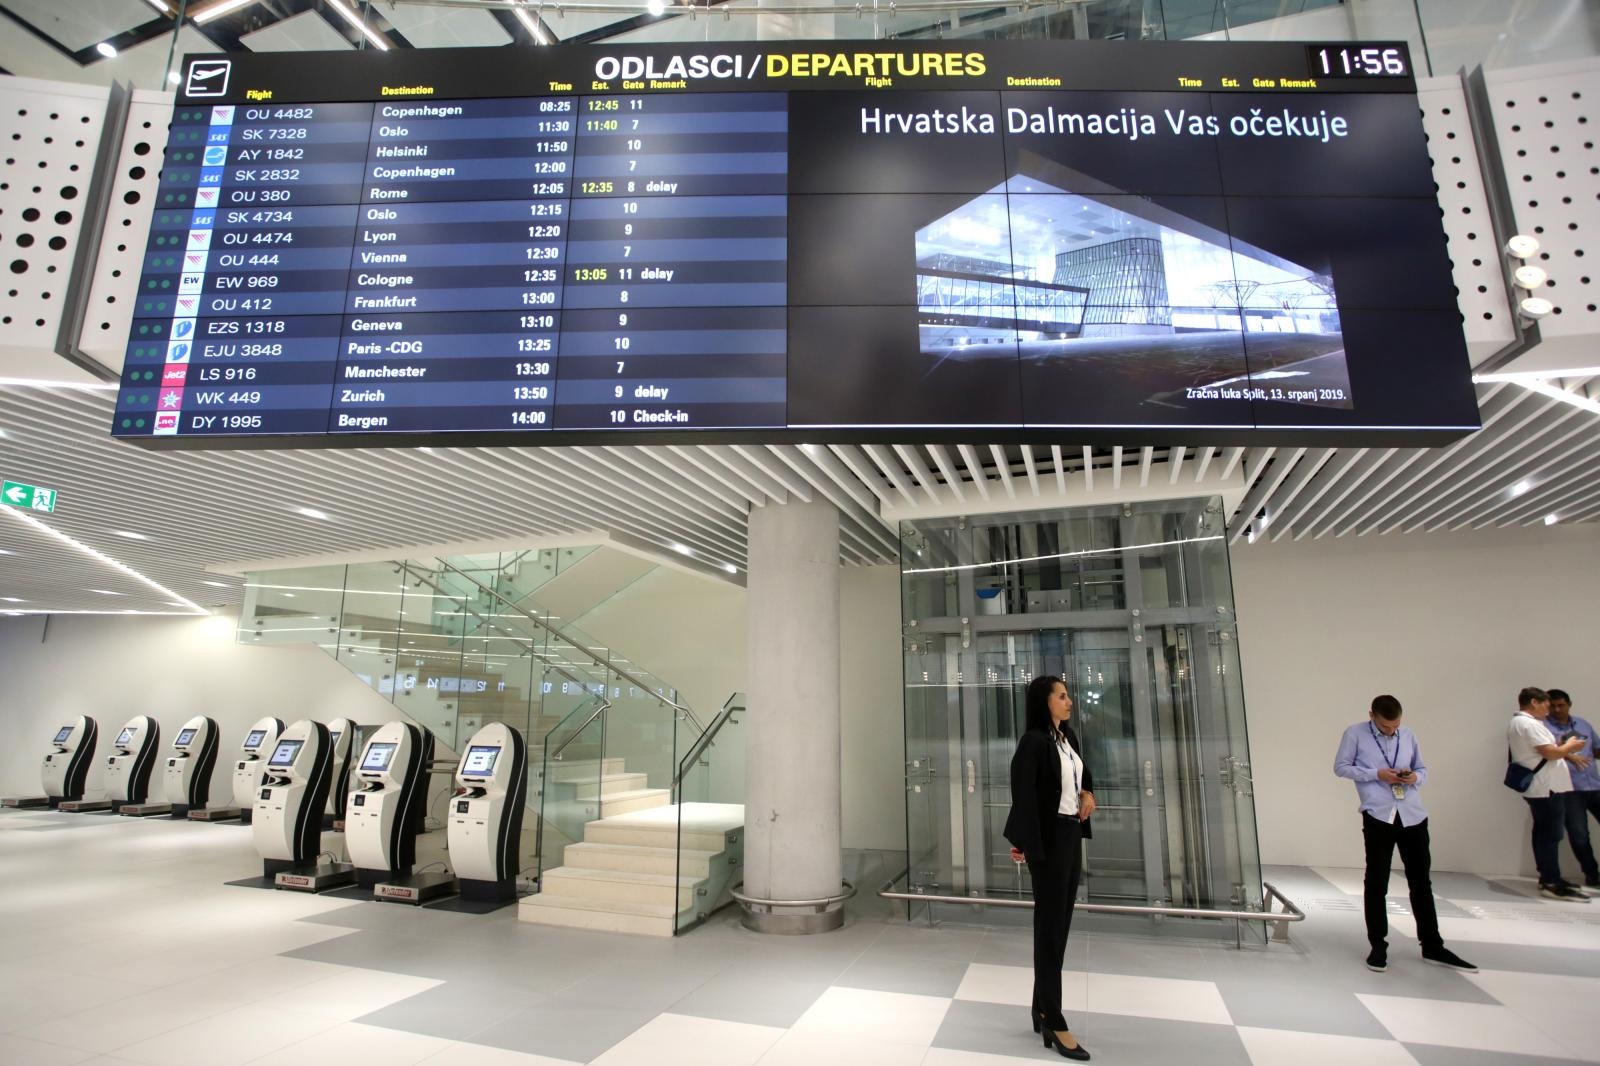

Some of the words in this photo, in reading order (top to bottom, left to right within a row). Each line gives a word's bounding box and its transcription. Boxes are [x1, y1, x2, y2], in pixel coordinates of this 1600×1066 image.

[1320, 49, 1404, 74] 11:56
[246, 90, 272, 101] Flight
[381, 85, 434, 95] Destination
[549, 82, 572, 91] Time
[592, 81, 609, 90] Est.
[623, 80, 645, 89] Gate
[650, 79, 686, 89] Remark
[865, 77, 892, 88] Flight
[1007, 77, 1061, 86] Destination
[1178, 77, 1202, 87] Time
[1222, 78, 1240, 87] Est.
[1253, 78, 1275, 87] Gate
[1280, 78, 1317, 88] Remark
[246, 109, 270, 120] OU
[274, 108, 313, 119] 4482
[382, 105, 462, 119] Copenhagen
[540, 101, 571, 112] 08:25
[588, 100, 619, 111] 12:45
[630, 99, 642, 110] 11
[242, 129, 264, 140] SK
[269, 128, 307, 139] 7328
[379, 126, 408, 137] Oslo
[539, 121, 570, 132] 11:30
[587, 120, 618, 131] 11:40
[632, 120, 639, 130] 7
[862, 106, 994, 133] Hrvatska
[1007, 106, 1156, 140] Dalmacija
[1164, 109, 1220, 135] Vas
[1230, 108, 1348, 143] očekuje
[238, 149, 261, 160] AY
[266, 148, 304, 159] 1842
[376, 145, 428, 157] Helsinki
[537, 141, 568, 152] 11:50
[628, 139, 641, 150] 10
[235, 170, 256, 181] SK
[260, 169, 300, 180] 2832
[373, 166, 455, 180] Copenhagen
[535, 162, 566, 173] 12:00
[629, 160, 636, 171] 7
[231, 191, 256, 202] OU
[260, 190, 290, 201] 380
[370, 188, 408, 199] Rome
[533, 183, 564, 194] 12:05
[582, 182, 613, 193] 12:35
[628, 181, 635, 192] 8
[646, 180, 678, 194] delay
[227, 212, 249, 223] SK
[252, 211, 293, 222] 4734
[367, 209, 397, 220] Oslo
[531, 204, 562, 215] 12:15
[623, 202, 637, 213] 10
[223, 233, 248, 245] OU
[252, 232, 293, 244] 4474
[364, 231, 396, 244] Lyon
[529, 225, 560, 237] 12:20
[625, 224, 632, 235] 9
[219, 255, 244, 266] OU
[248, 254, 279, 265] 444
[361, 252, 407, 263] Vienna
[526, 247, 559, 259] 12:30
[624, 246, 631, 257] 7
[216, 277, 244, 288] EW
[248, 276, 278, 288] 969
[358, 274, 413, 287] Cologne
[524, 270, 556, 281] 12:35
[575, 269, 607, 280] 13:05
[619, 268, 632, 280] 11
[641, 267, 674, 281] delay
[212, 299, 237, 311] OU
[241, 298, 272, 310] 412
[354, 296, 417, 308] Frankfurt
[522, 292, 555, 304] 13:00
[620, 290, 628, 303] 8
[208, 322, 239, 334] EZS
[246, 321, 285, 333] 1318
[351, 319, 402, 331] Geneva
[520, 315, 553, 328] 13:10
[619, 314, 627, 326] 9
[204, 345, 236, 357] EJU
[240, 344, 282, 356] 3848
[348, 342, 381, 354] Paris
[385, 341, 422, 353] -CDG
[518, 339, 551, 351] 13:25
[615, 337, 630, 349] 10
[200, 368, 220, 380] LS
[225, 368, 256, 380] 916
[345, 365, 426, 378] Manchester
[516, 363, 550, 375] 13:30
[617, 361, 624, 373] 7
[196, 392, 225, 404] WK
[228, 391, 261, 403] 449
[341, 389, 385, 402] Zurich
[514, 387, 548, 399] 13:50
[615, 385, 623, 398] 9
[634, 385, 669, 400] delay
[1186, 388, 1219, 399] Zračna
[1220, 388, 1241, 399] luka
[1270, 389, 1286, 399] 13.
[1288, 389, 1318, 402] srpanj
[1319, 389, 1346, 400] 2019.
[192, 416, 216, 428] DY
[222, 416, 261, 428] 1995
[338, 414, 388, 429] Bergen
[512, 411, 546, 424] 14:00
[610, 410, 626, 423] 10
[633, 409, 688, 422] Check-in
